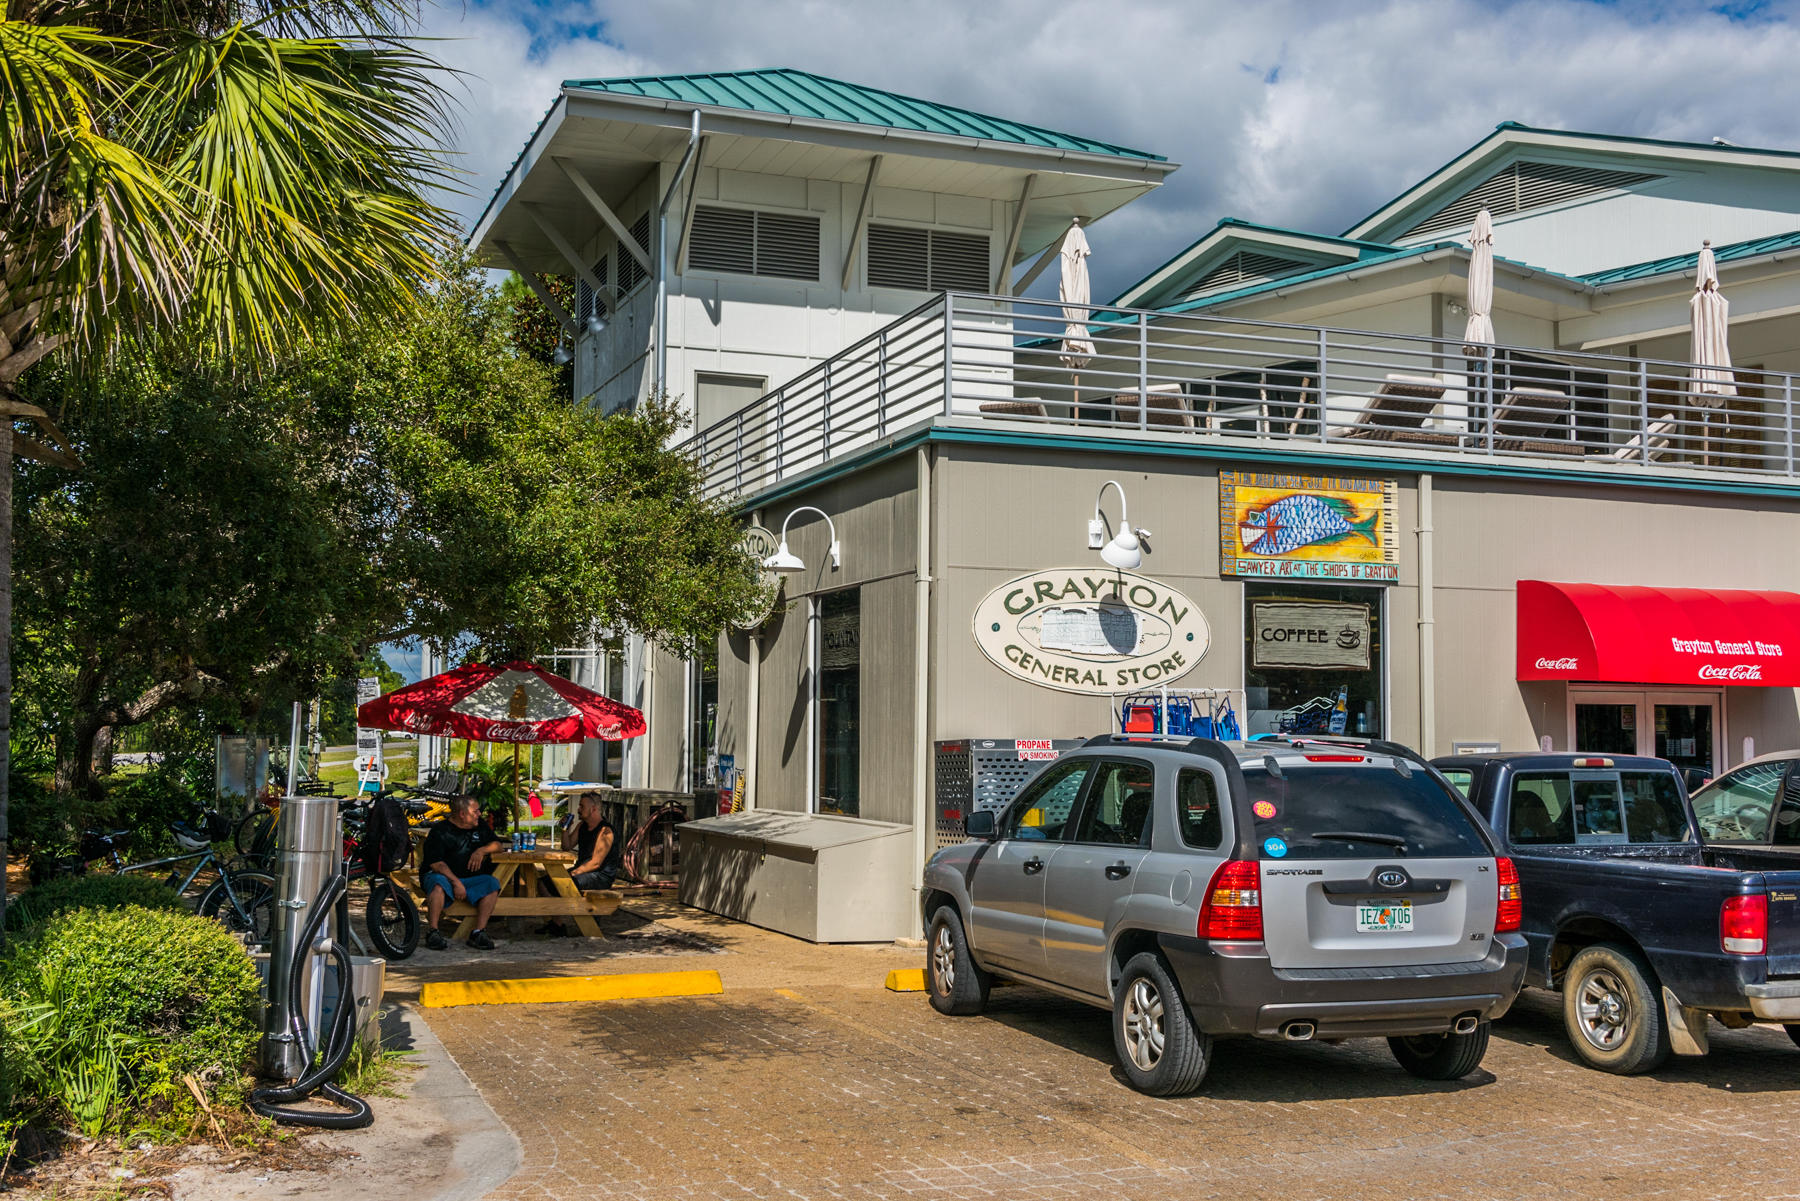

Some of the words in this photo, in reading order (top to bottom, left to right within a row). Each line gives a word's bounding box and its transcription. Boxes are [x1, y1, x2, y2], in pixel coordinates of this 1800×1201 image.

[1238, 560, 1276, 575] SAWYER
[1279, 561, 1293, 575] ART
[1293, 563, 1300, 572] AT
[1305, 562, 1318, 576] THE
[1323, 563, 1348, 577] SHOPS
[1351, 564, 1360, 578] OF
[1364, 564, 1398, 579] GRAYTON
[1004, 577, 1189, 625] GRAYTON
[1261, 628, 1329, 643] COFFEE
[1671, 637, 1714, 656] Grayton
[1714, 639, 1755, 655] General
[1755, 641, 1783, 656] Store
[1004, 644, 1108, 686] GENERAL
[1117, 651, 1186, 686] STORE
[1535, 657, 1579, 670] Coca-Cola
[1698, 664, 1762, 680] Coca-Cola
[486, 723, 542, 741] Coca-Cola
[1016, 740, 1051, 749] PROPANE
[1019, 751, 1029, 760] NO
[1030, 751, 1059, 760] SMOKING
[1360, 908, 1379, 925] IEZ
[1392, 907, 1411, 924] T06
